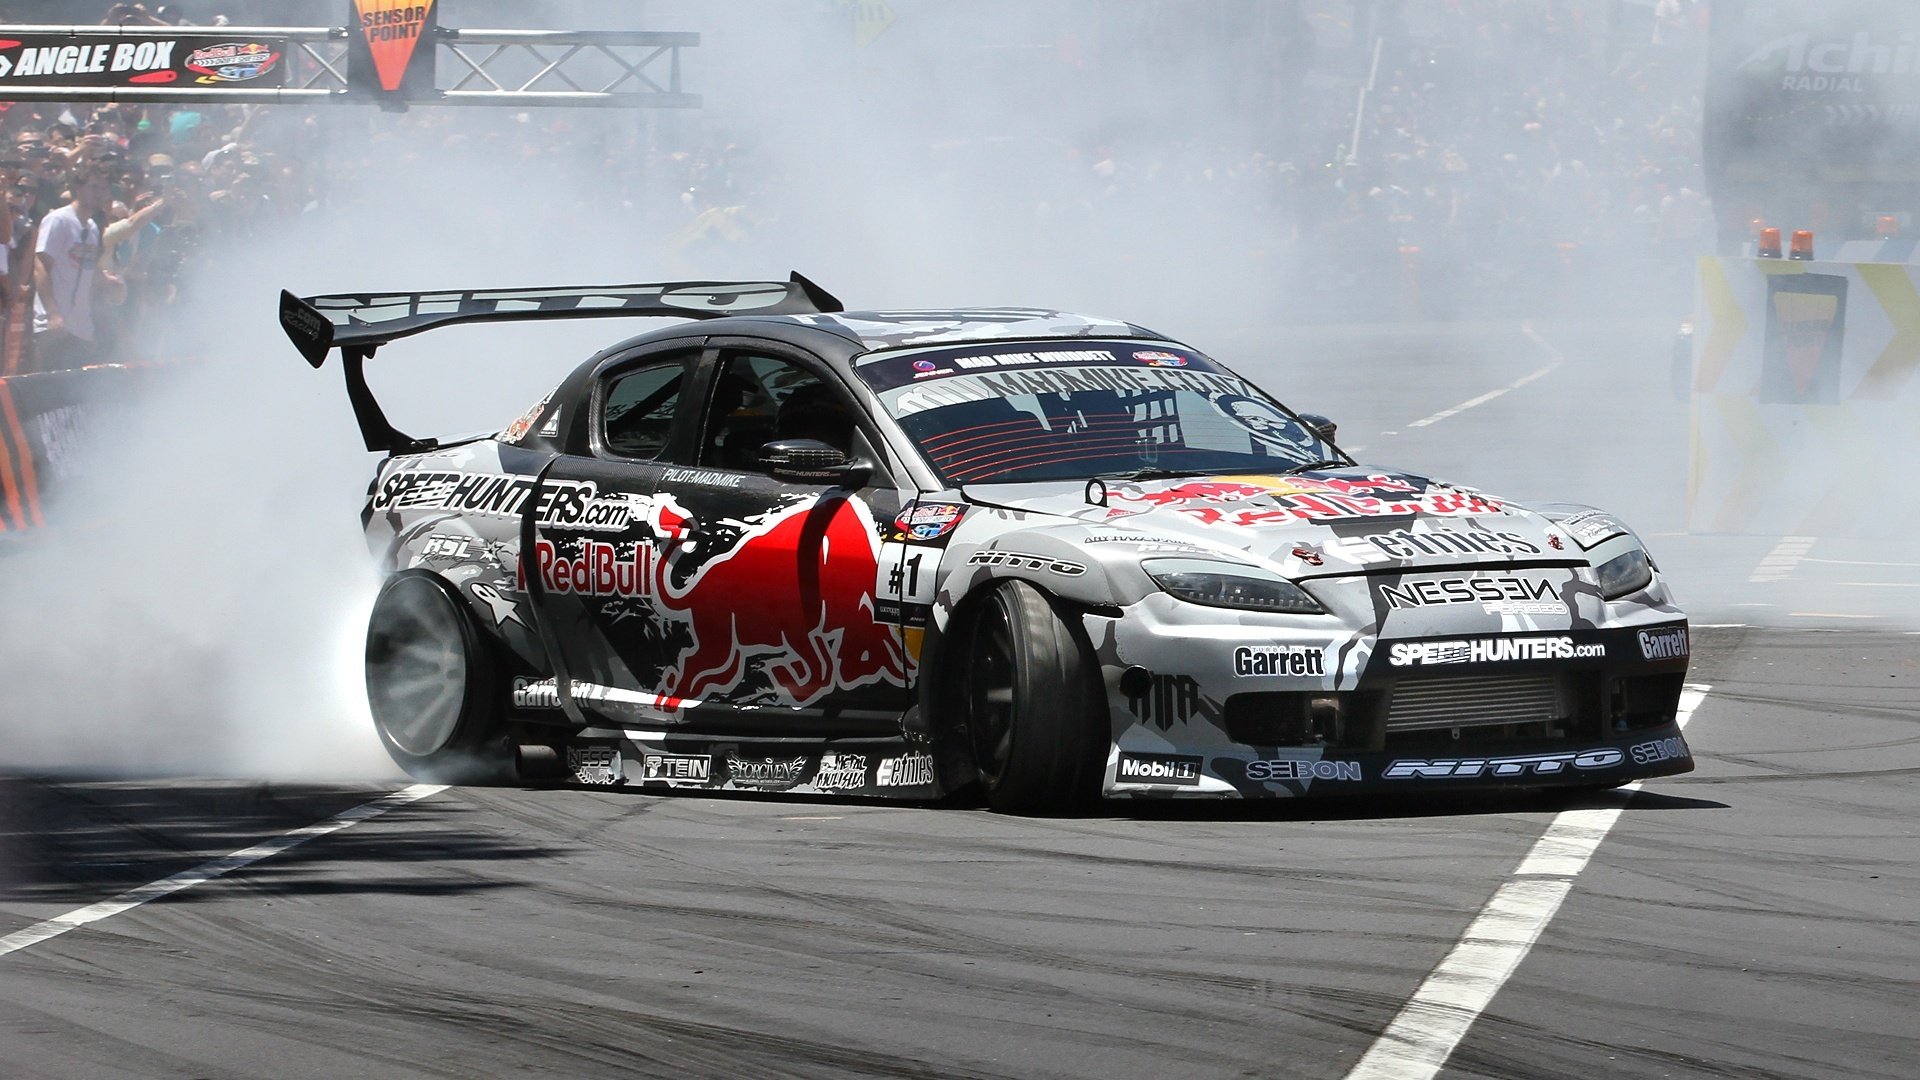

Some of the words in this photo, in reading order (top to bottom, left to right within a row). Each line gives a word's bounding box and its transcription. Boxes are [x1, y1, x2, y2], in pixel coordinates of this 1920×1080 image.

[362, 6, 425, 28] SENSOR
[369, 22, 419, 43] POINT
[13, 45, 110, 77] ANGLE
[110, 40, 176, 72] BOX
[1781, 76, 1865, 92] RADIAL
[314, 282, 788, 326] NITTO
[954, 356, 997, 369] MAD
[993, 353, 1040, 366] MIKE
[1369, 528, 1542, 558] etnies
[968, 550, 1088, 576] NITTO
[1388, 636, 1606, 666] SPEEDHUNTERS.com
[1638, 629, 1688, 660] Garrett
[1234, 647, 1325, 676] Garrett
[663, 758, 709, 778] TEIN
[738, 759, 794, 780] FORGIVEN
[836, 755, 868, 772] METAL
[891, 751, 934, 786] etnies
[1121, 759, 1176, 778] Mobil
[1246, 760, 1361, 781] SEIBON
[1383, 747, 1623, 778] NITTO
